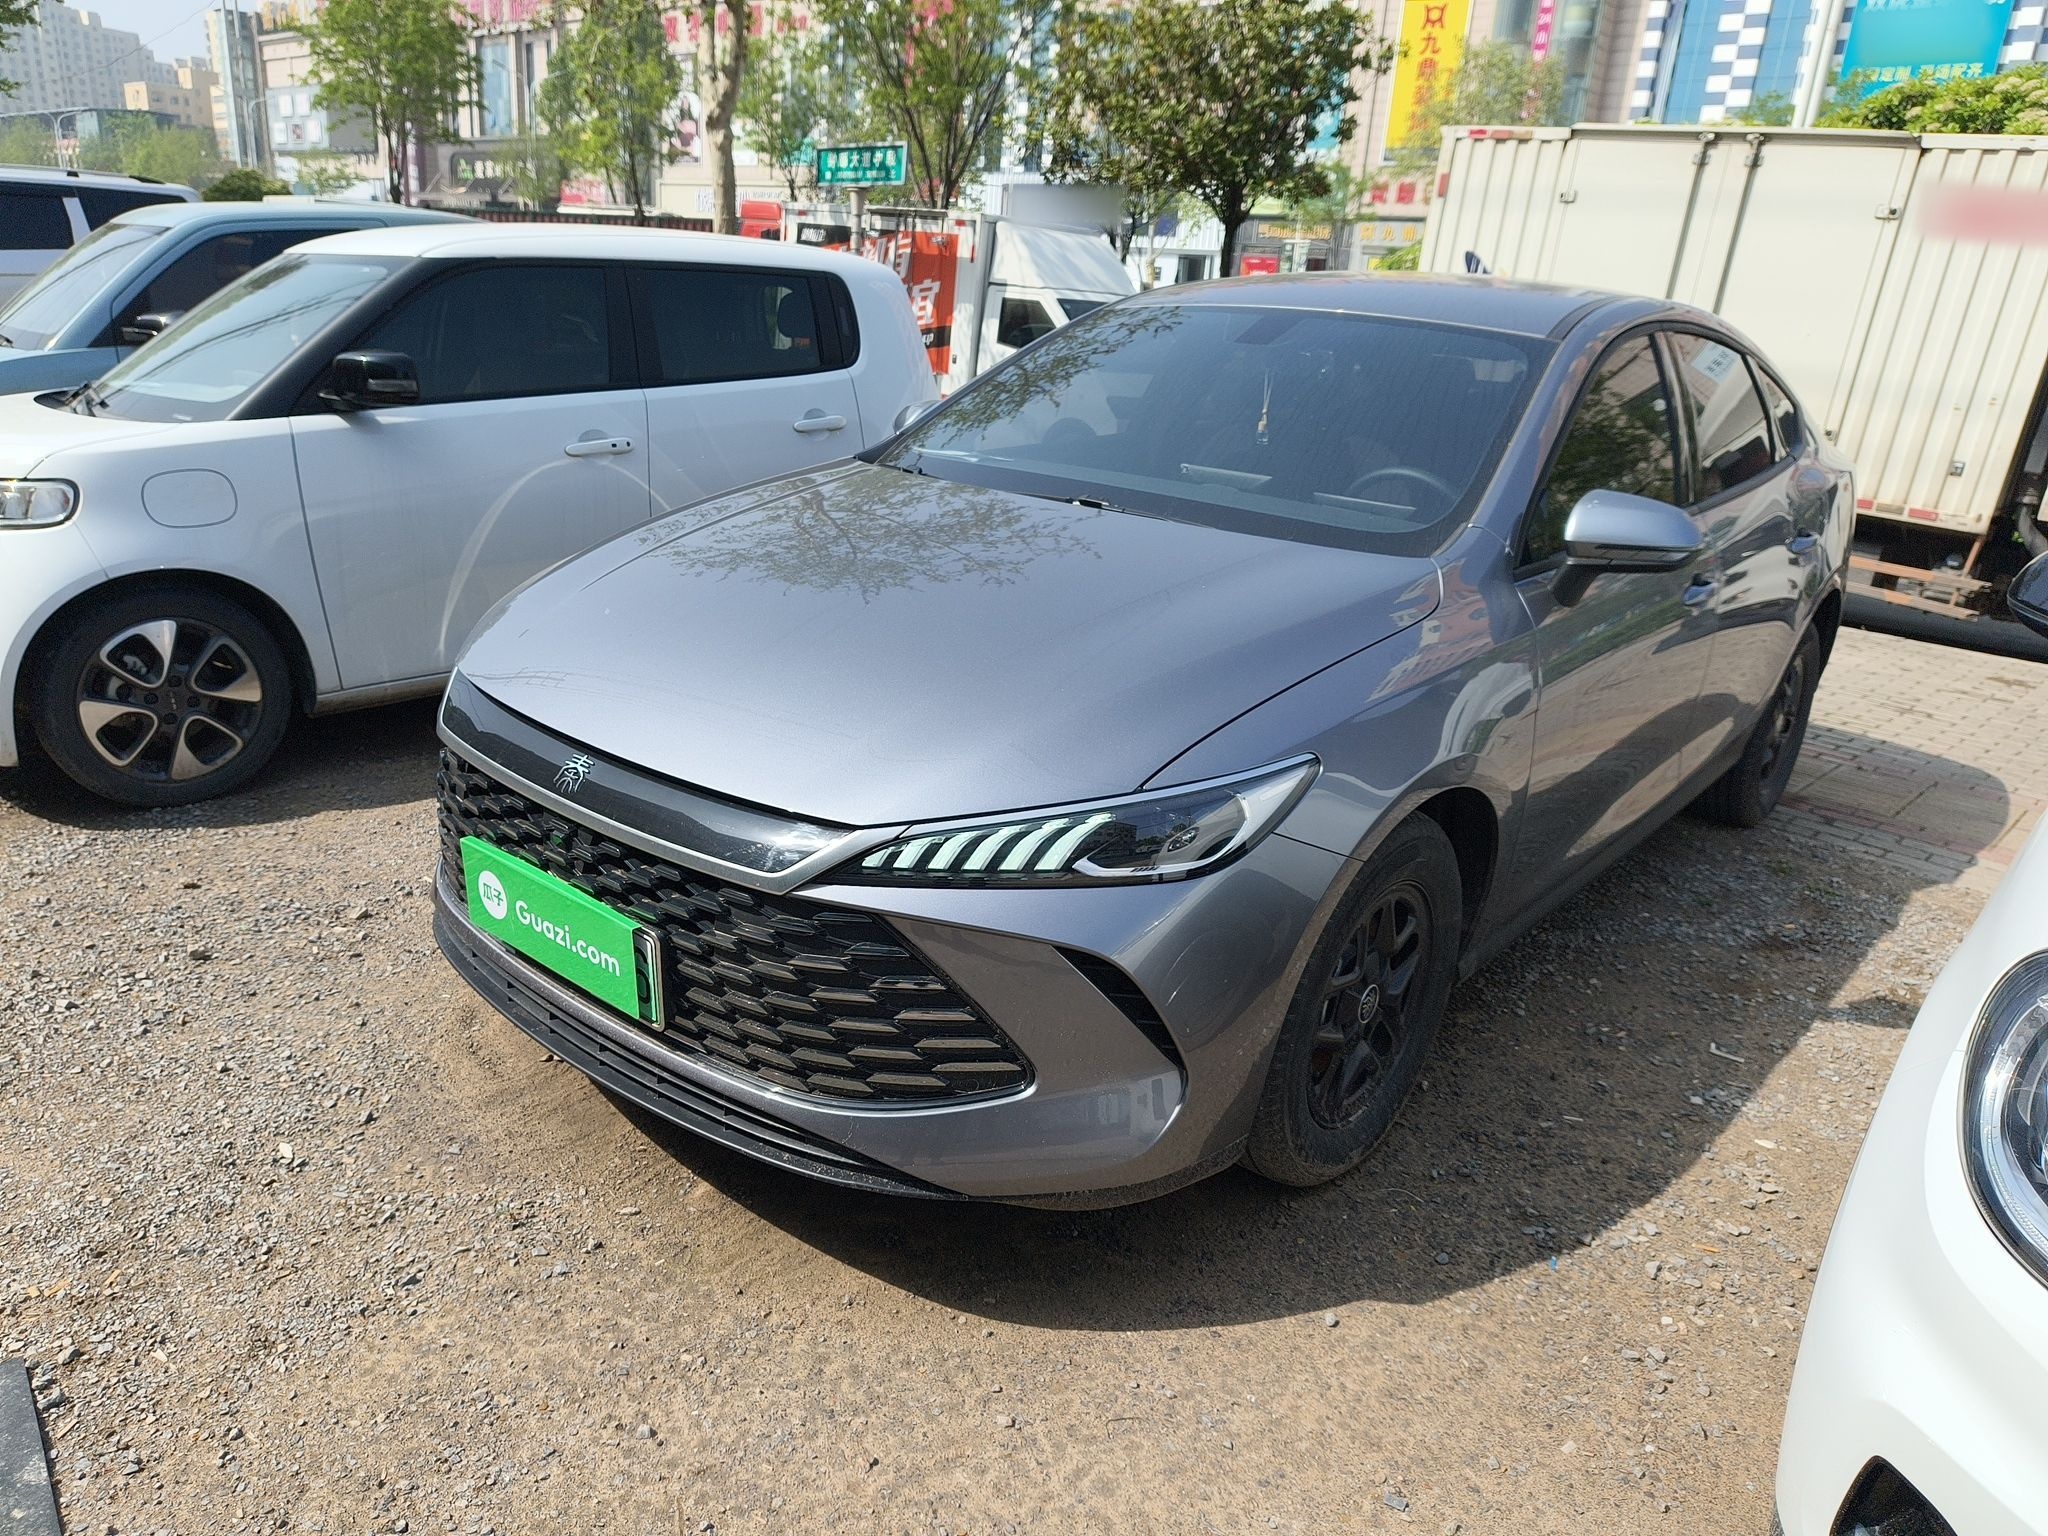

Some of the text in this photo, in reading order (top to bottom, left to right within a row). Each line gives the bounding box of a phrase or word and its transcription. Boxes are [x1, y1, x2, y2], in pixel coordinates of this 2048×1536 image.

[553, 753, 595, 794] 秦
[482, 882, 504, 906] 瓜子
[515, 900, 621, 977] Guazi.com
